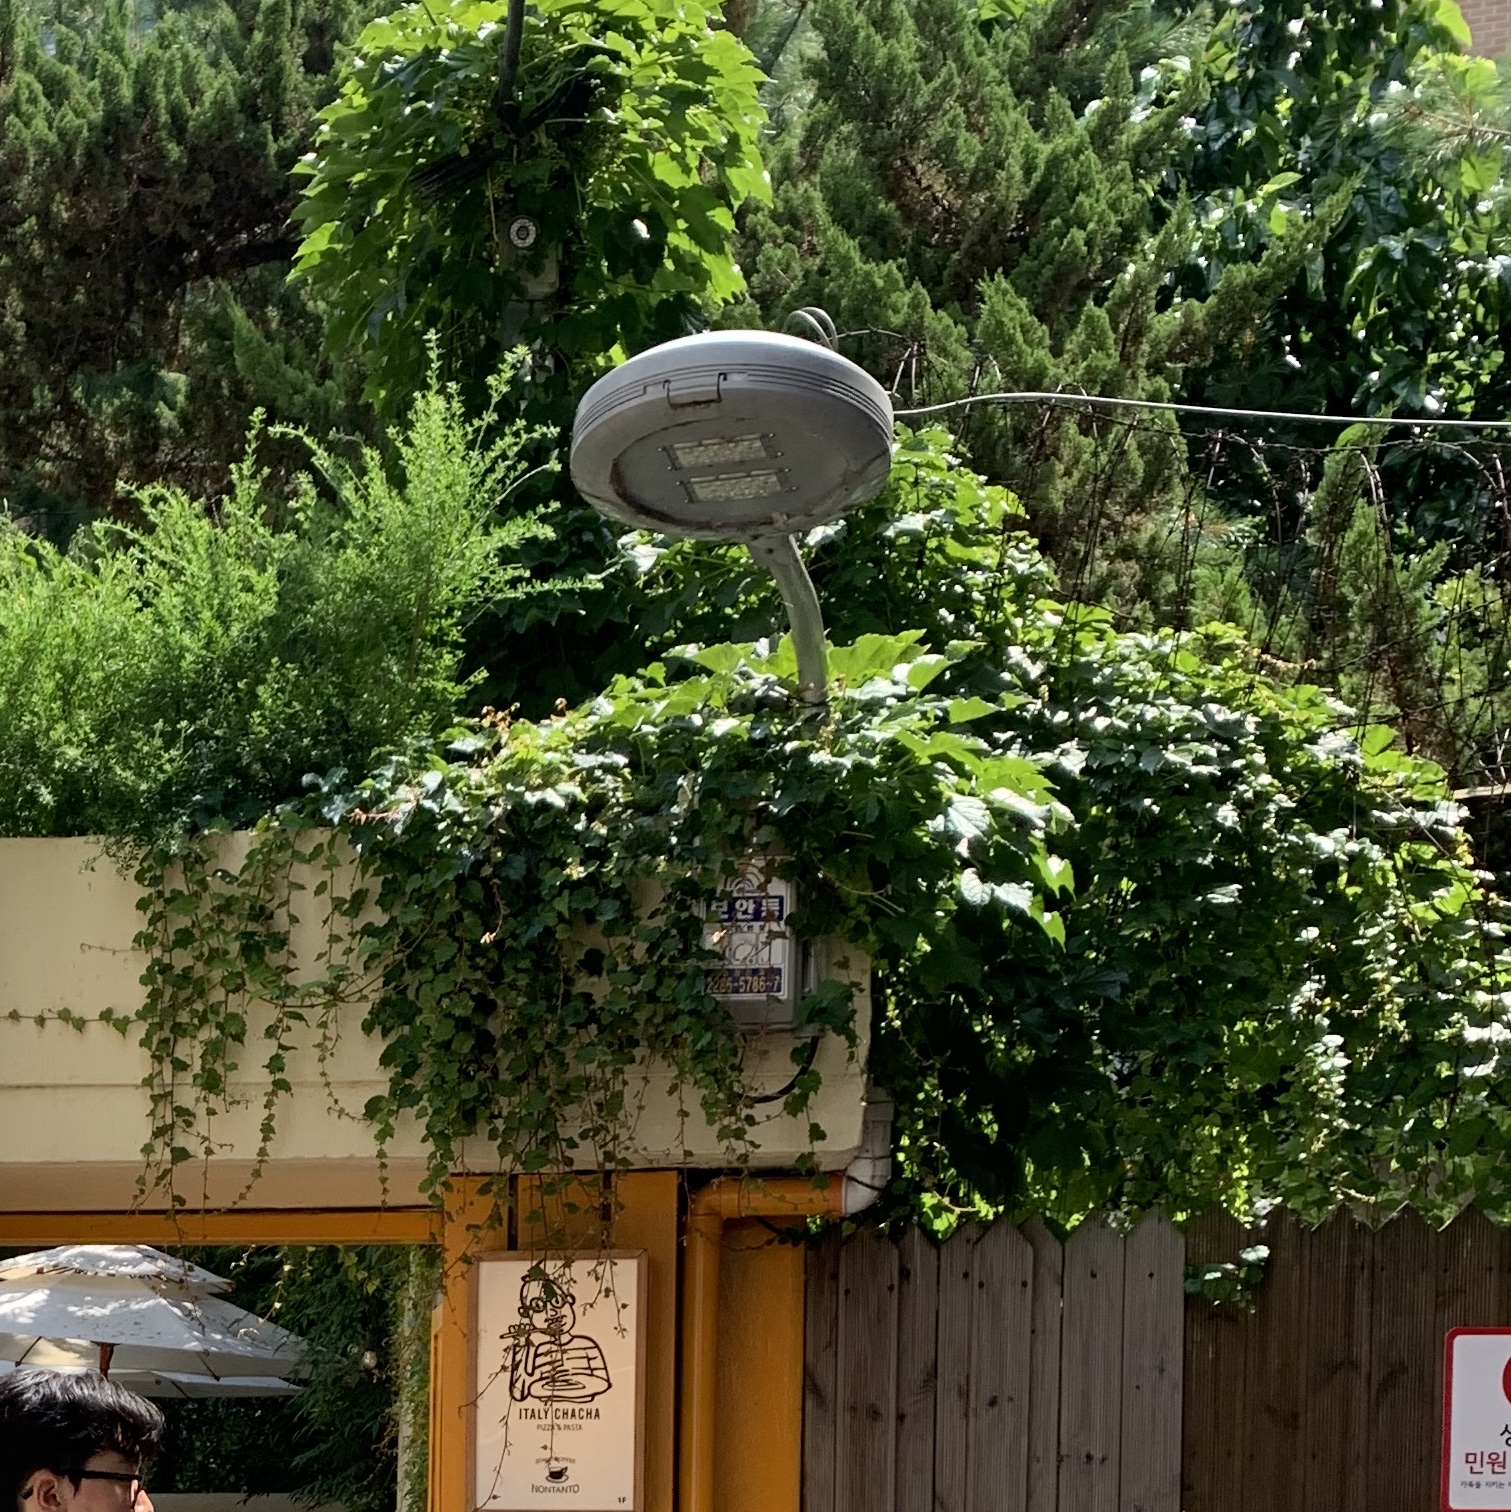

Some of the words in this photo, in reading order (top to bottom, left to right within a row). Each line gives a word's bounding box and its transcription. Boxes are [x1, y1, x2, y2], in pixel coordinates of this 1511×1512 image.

[519, 1407, 550, 1420] ITALY
[554, 1407, 601, 1420] CHACHA
[536, 1423, 555, 1431] PIZZA
[563, 1423, 583, 1431] PASTA
[1465, 1450, 1506, 1475] 민원
[531, 1484, 580, 1494] NONTANTO
